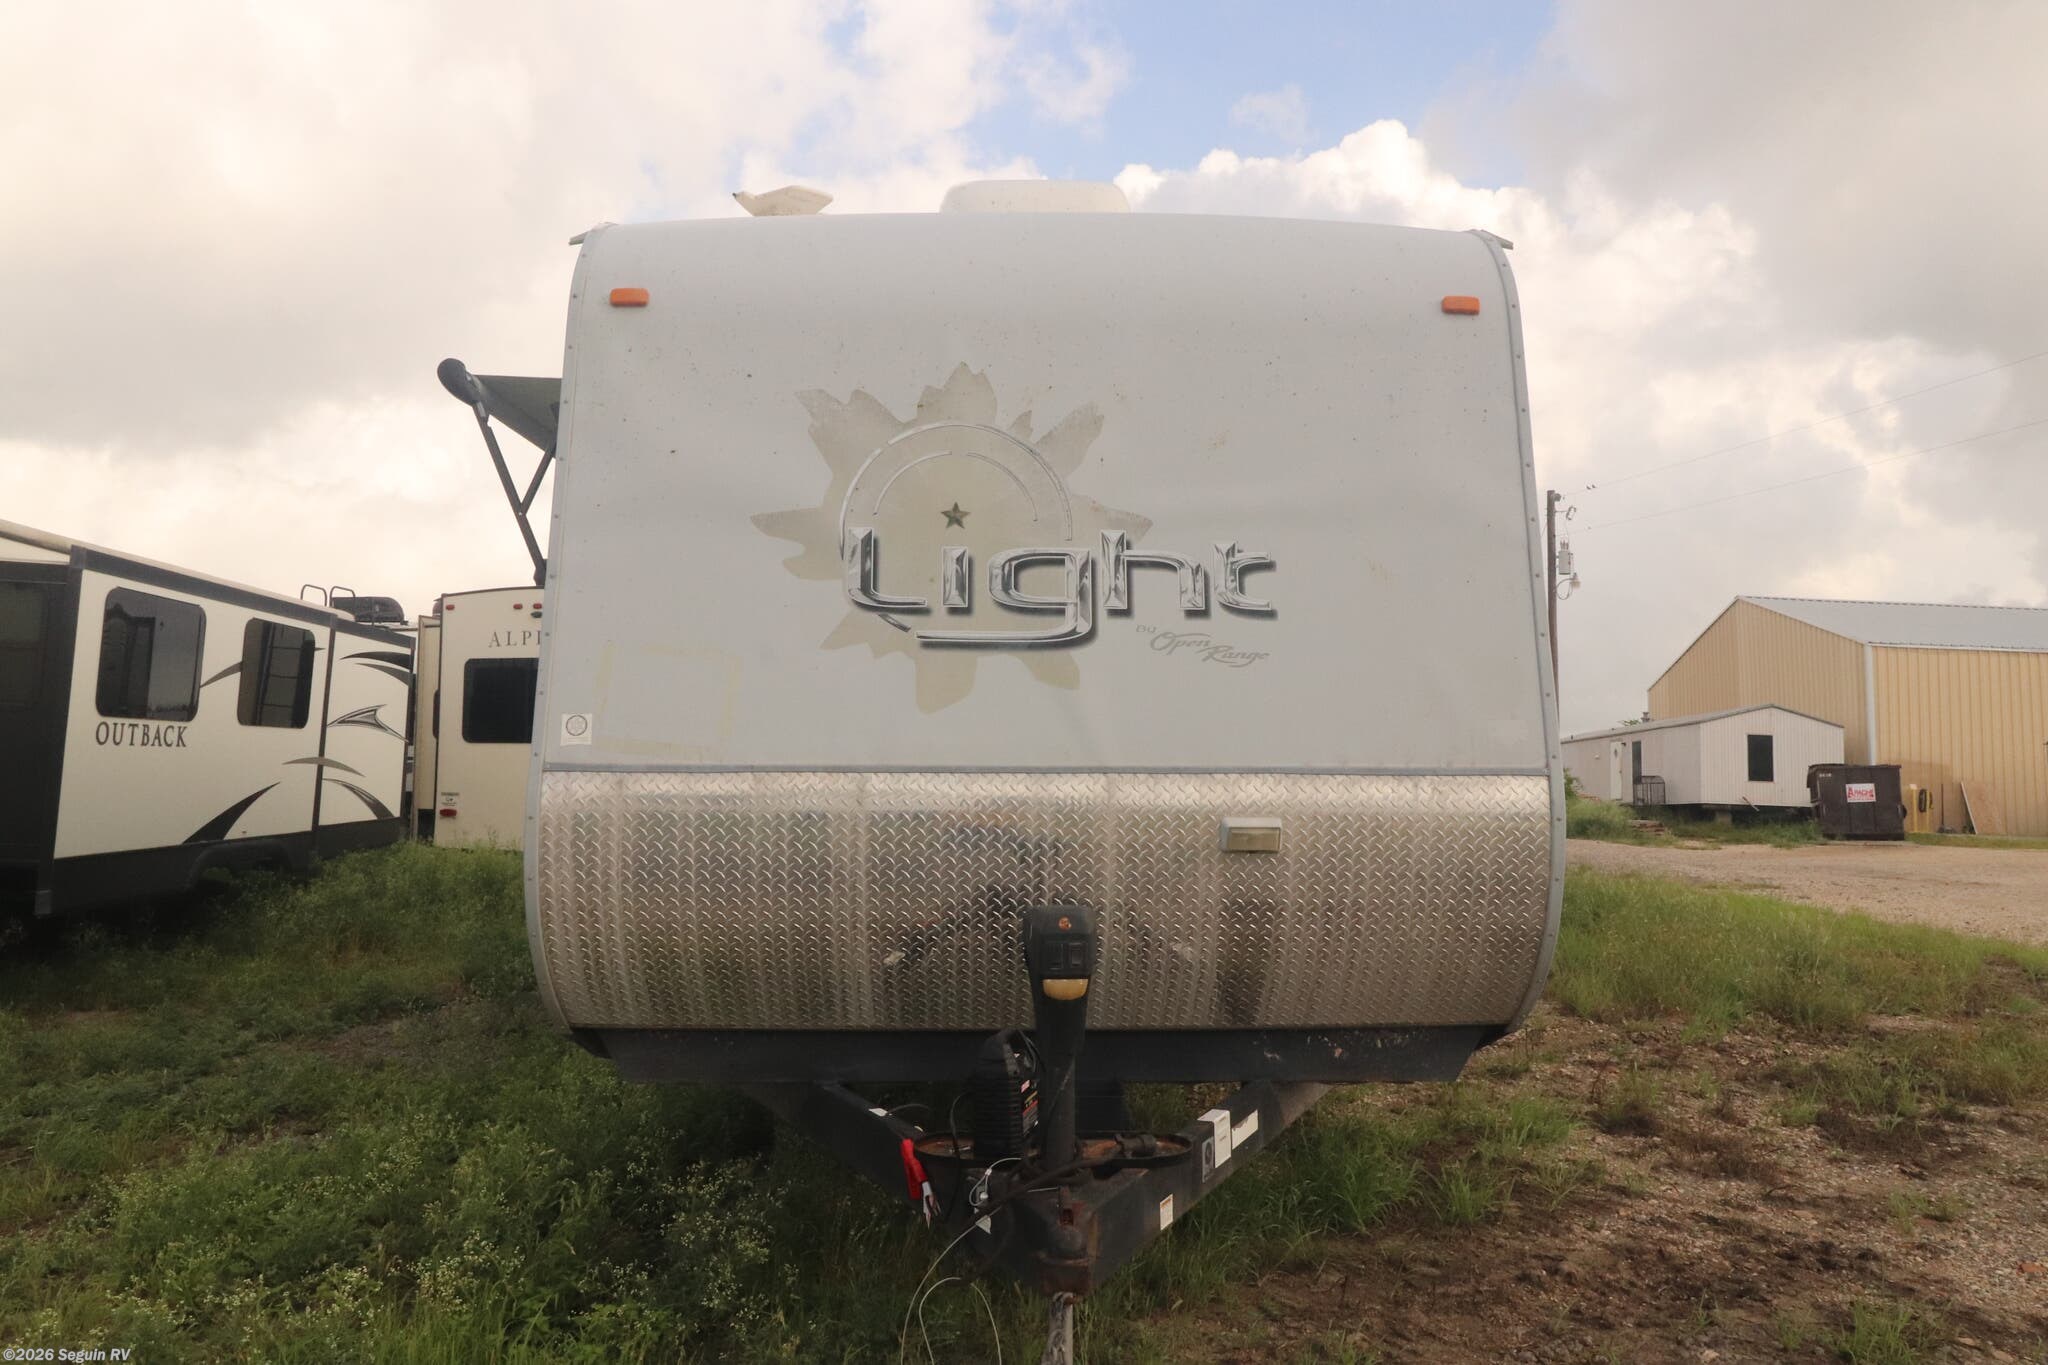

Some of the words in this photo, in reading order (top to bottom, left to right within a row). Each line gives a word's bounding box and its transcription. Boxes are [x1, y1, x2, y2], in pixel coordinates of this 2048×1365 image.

[847, 527, 1274, 645] Light
[1150, 631, 1212, 656] Open
[1195, 645, 1270, 668] Range
[95, 721, 187, 747] OUTBACK
